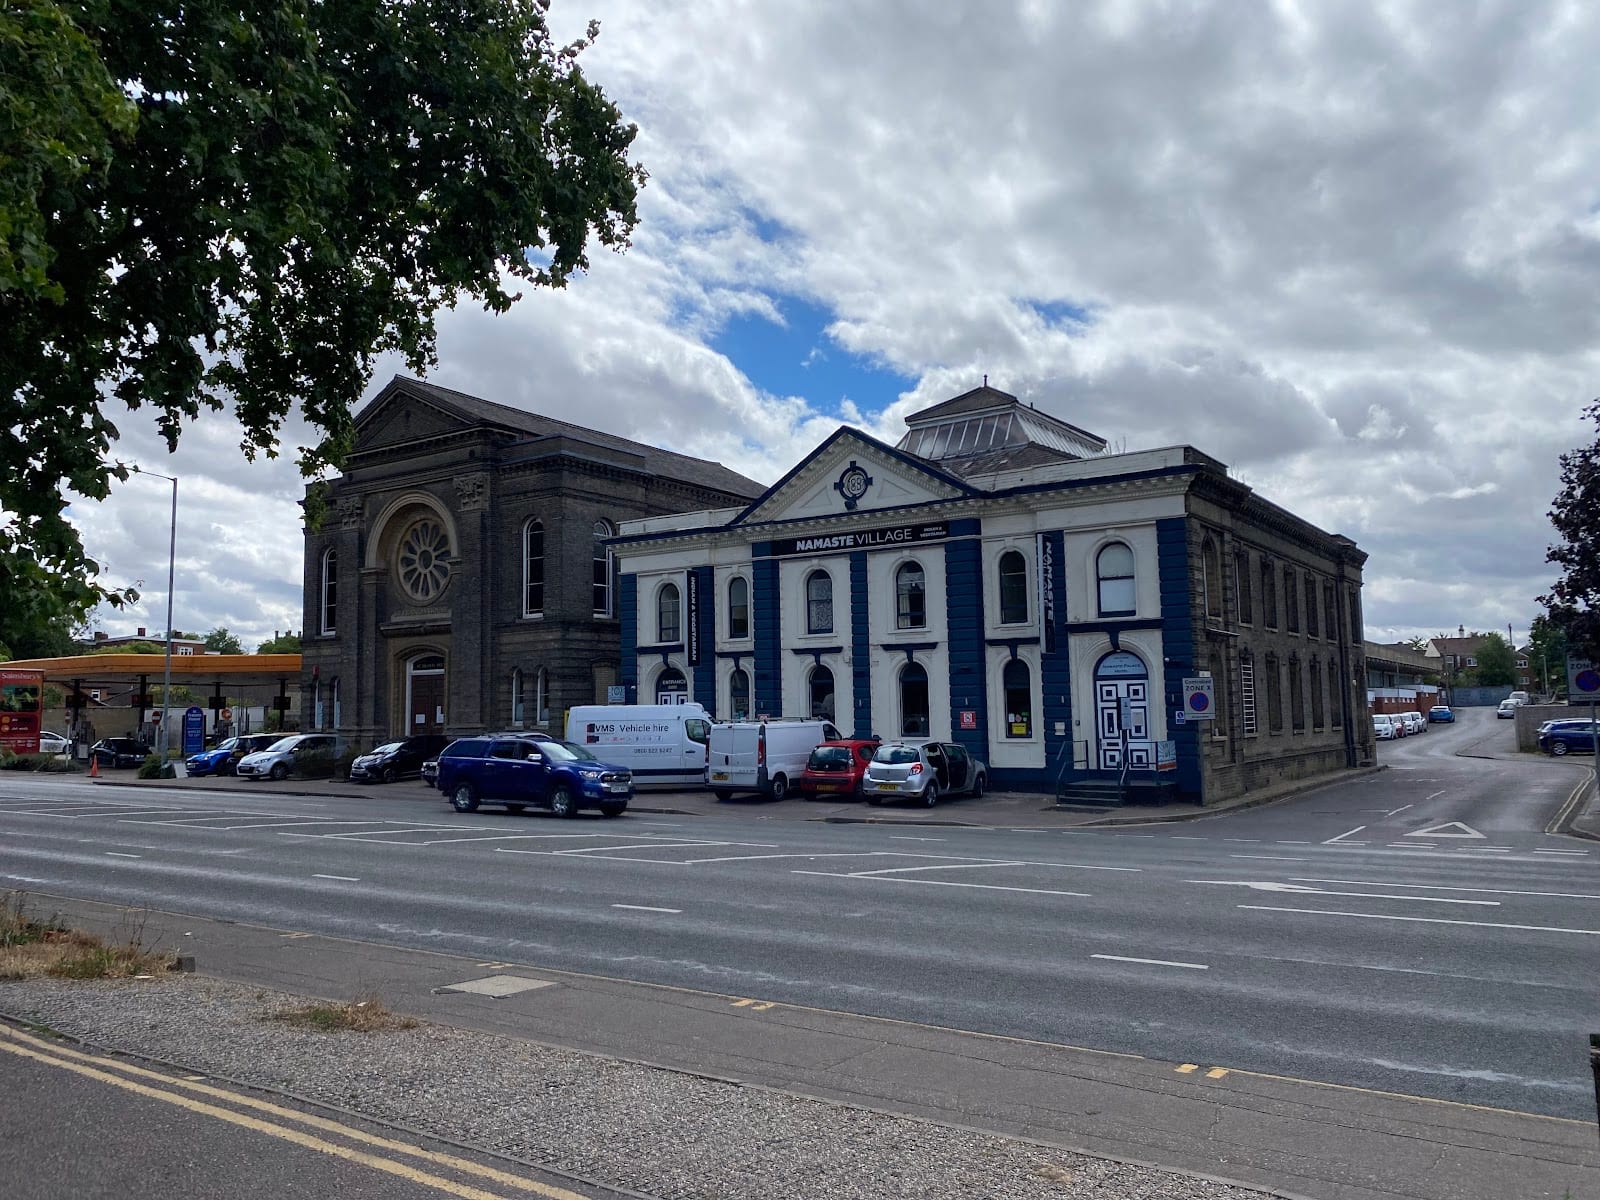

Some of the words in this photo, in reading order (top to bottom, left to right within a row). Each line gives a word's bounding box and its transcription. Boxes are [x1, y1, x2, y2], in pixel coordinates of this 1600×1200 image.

[797, 535, 854, 551] NAMASTE
[855, 528, 912, 545] VILLAGE
[1046, 541, 1054, 620] NAMASTE
[595, 724, 615, 732] VMS
[619, 724, 651, 732] Vehicle
[653, 724, 669, 732] hire
